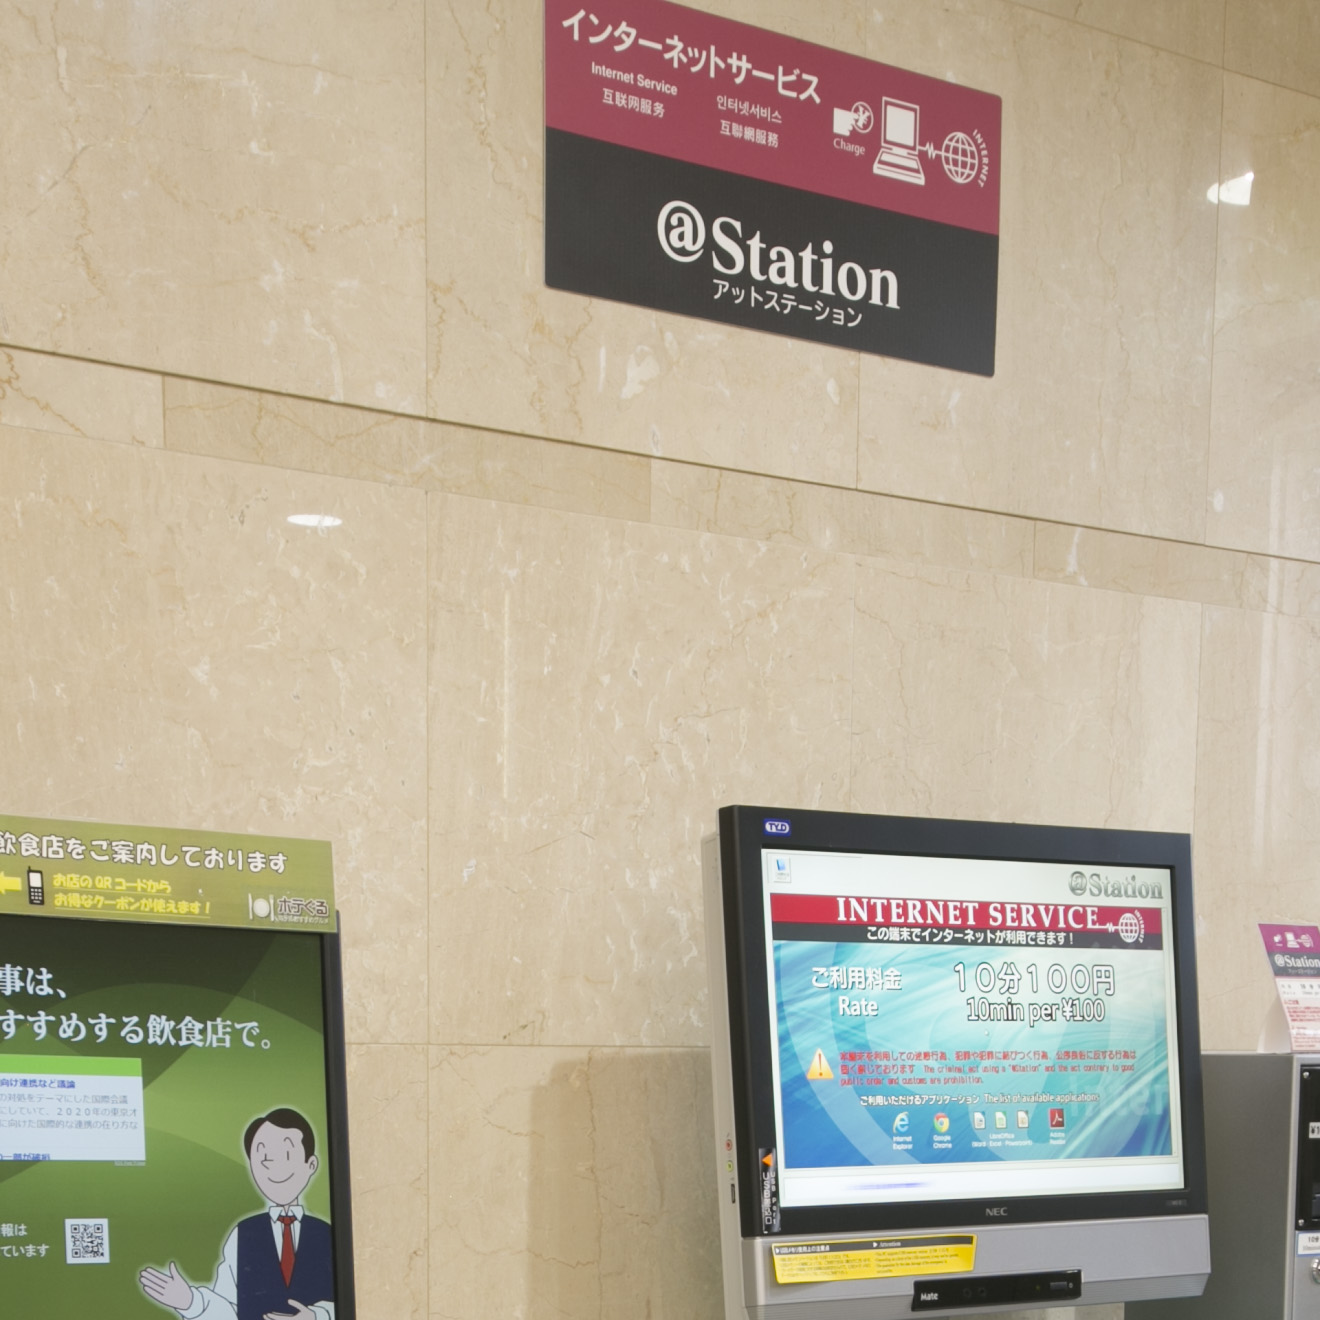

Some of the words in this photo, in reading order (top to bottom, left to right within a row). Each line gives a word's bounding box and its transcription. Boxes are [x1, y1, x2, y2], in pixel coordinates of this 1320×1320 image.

[562, 9, 821, 104] インターネットサービス
[591, 62, 635, 87] Internet
[636, 72, 678, 96] Service
[602, 88, 665, 118] 互联网服务
[716, 95, 783, 123] 인터넷서비스
[719, 120, 779, 148] 互聯網服務
[833, 137, 866, 156] Charge
[973, 129, 989, 187] INTERNET
[657, 200, 900, 309] @Station
[712, 279, 863, 327] アットステーション
[1068, 871, 1164, 899] @Station
[278, 896, 329, 917] ホテぐる
[837, 897, 979, 926] INTERNET
[988, 902, 1099, 929] SERVICE
[811, 967, 903, 992] ご利用料金
[838, 996, 878, 1016] Rate
[967, 997, 1024, 1023] 10min
[1029, 1002, 1059, 1028] per
[1062, 998, 1106, 1023] ¥100
[860, 1094, 980, 1106] ご利用いただけるアプリケーション
[983, 1094, 998, 1103] The
[1000, 1093, 1011, 1103] list
[1022, 1092, 1055, 1103] available
[1056, 1092, 1099, 1104] applications
[985, 1207, 1008, 1216] NEC
[920, 1291, 939, 1301] Mate
